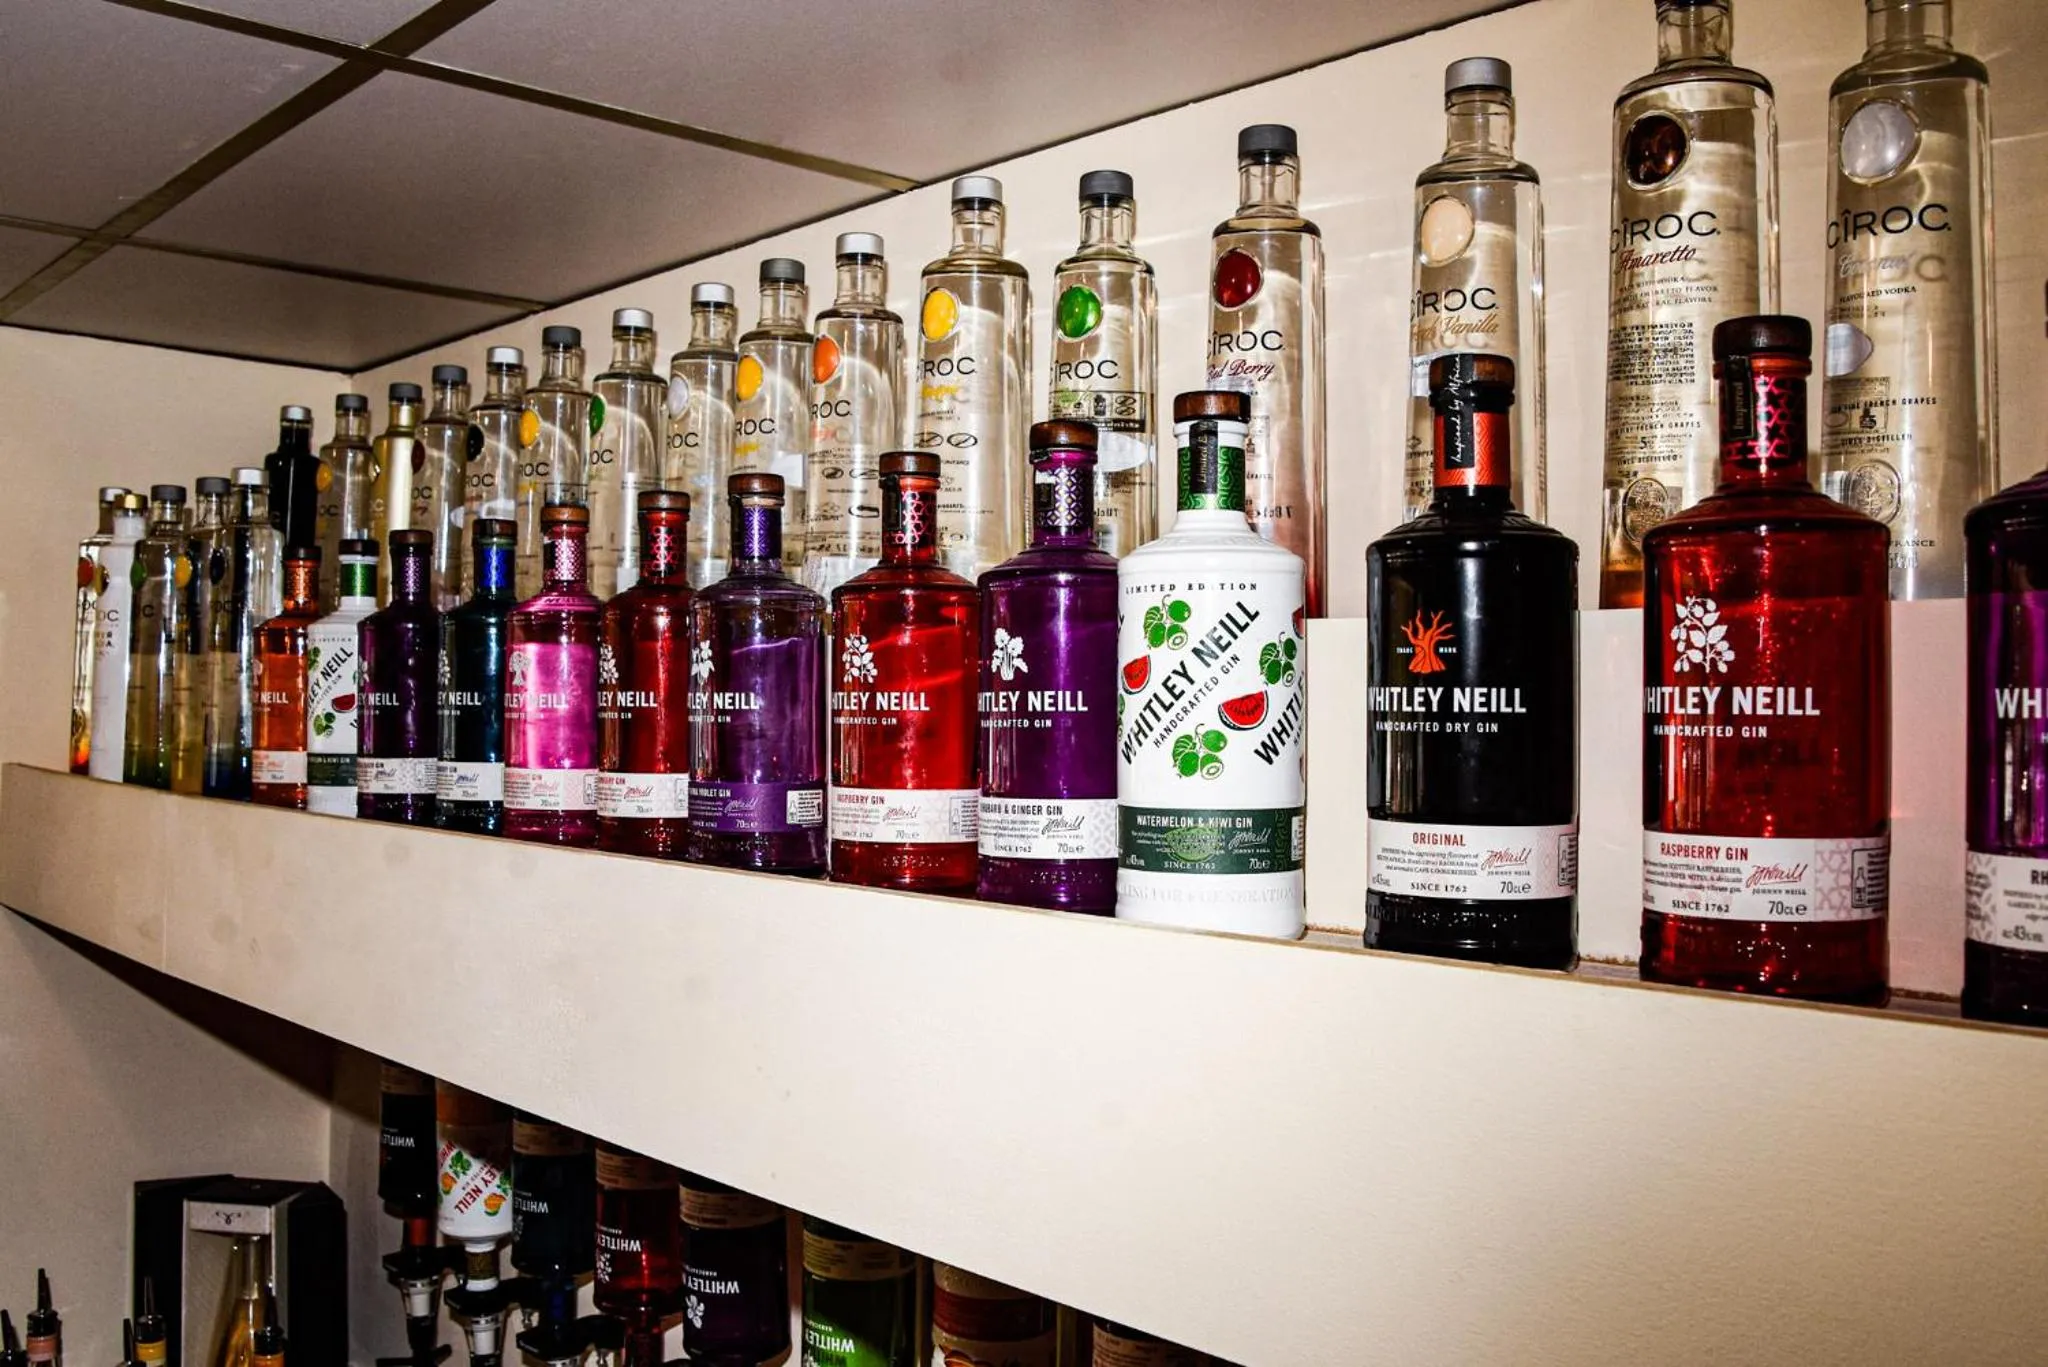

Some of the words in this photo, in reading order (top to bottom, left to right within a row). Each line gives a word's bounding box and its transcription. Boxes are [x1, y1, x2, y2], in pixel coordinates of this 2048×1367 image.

[1619, 244, 1697, 271] Amaretto
[1884, 285, 1917, 296] VODKA
[1443, 313, 1500, 337] Vanilla
[1229, 358, 1275, 382] Berry
[1902, 397, 1937, 405] GRAPES
[1188, 582, 1258, 591] EDTION
[320, 647, 354, 681] NEILL
[1121, 660, 1195, 765] WHITLEY
[1191, 601, 1260, 668] NEILL
[260, 692, 288, 704] NEILL
[368, 692, 399, 706] NEILL
[449, 692, 481, 706] NEILL
[617, 691, 657, 707] NEILL
[713, 692, 760, 710] NEILL
[876, 691, 930, 711] NEILL
[1027, 691, 1088, 712] NEILL
[1153, 676, 1219, 749] HANDCRAFTED
[1220, 653, 1241, 675] GIN
[1453, 687, 1527, 713] NEILL
[1645, 686, 1721, 715] HITLEY
[1732, 687, 1821, 715] NEILL
[1995, 687, 2048, 719] WH
[1034, 719, 1052, 728] GIN
[1446, 722, 1470, 733] DRY
[1476, 723, 1499, 733] GIN
[1742, 726, 1768, 738] GIN
[718, 789, 731, 797] GIN
[871, 795, 885, 804] GIN
[1012, 805, 1043, 815] GINGER
[1046, 805, 1063, 815] GIN
[1136, 815, 1193, 827] WATERMELON
[1208, 817, 1232, 828] KIWI
[1235, 817, 1253, 828] GIN
[1412, 832, 1466, 847] ORIGINAL
[1660, 842, 1721, 860] RASPBERRY
[1726, 847, 1748, 861] GIN
[1411, 882, 1440, 892] SINCE
[1444, 884, 1468, 893] 1762
[1672, 899, 1701, 911] SINCE
[1705, 901, 1729, 913] 1762
[454, 1184, 483, 1214] NEILL
[687, 1276, 740, 1294] WHITLEY
